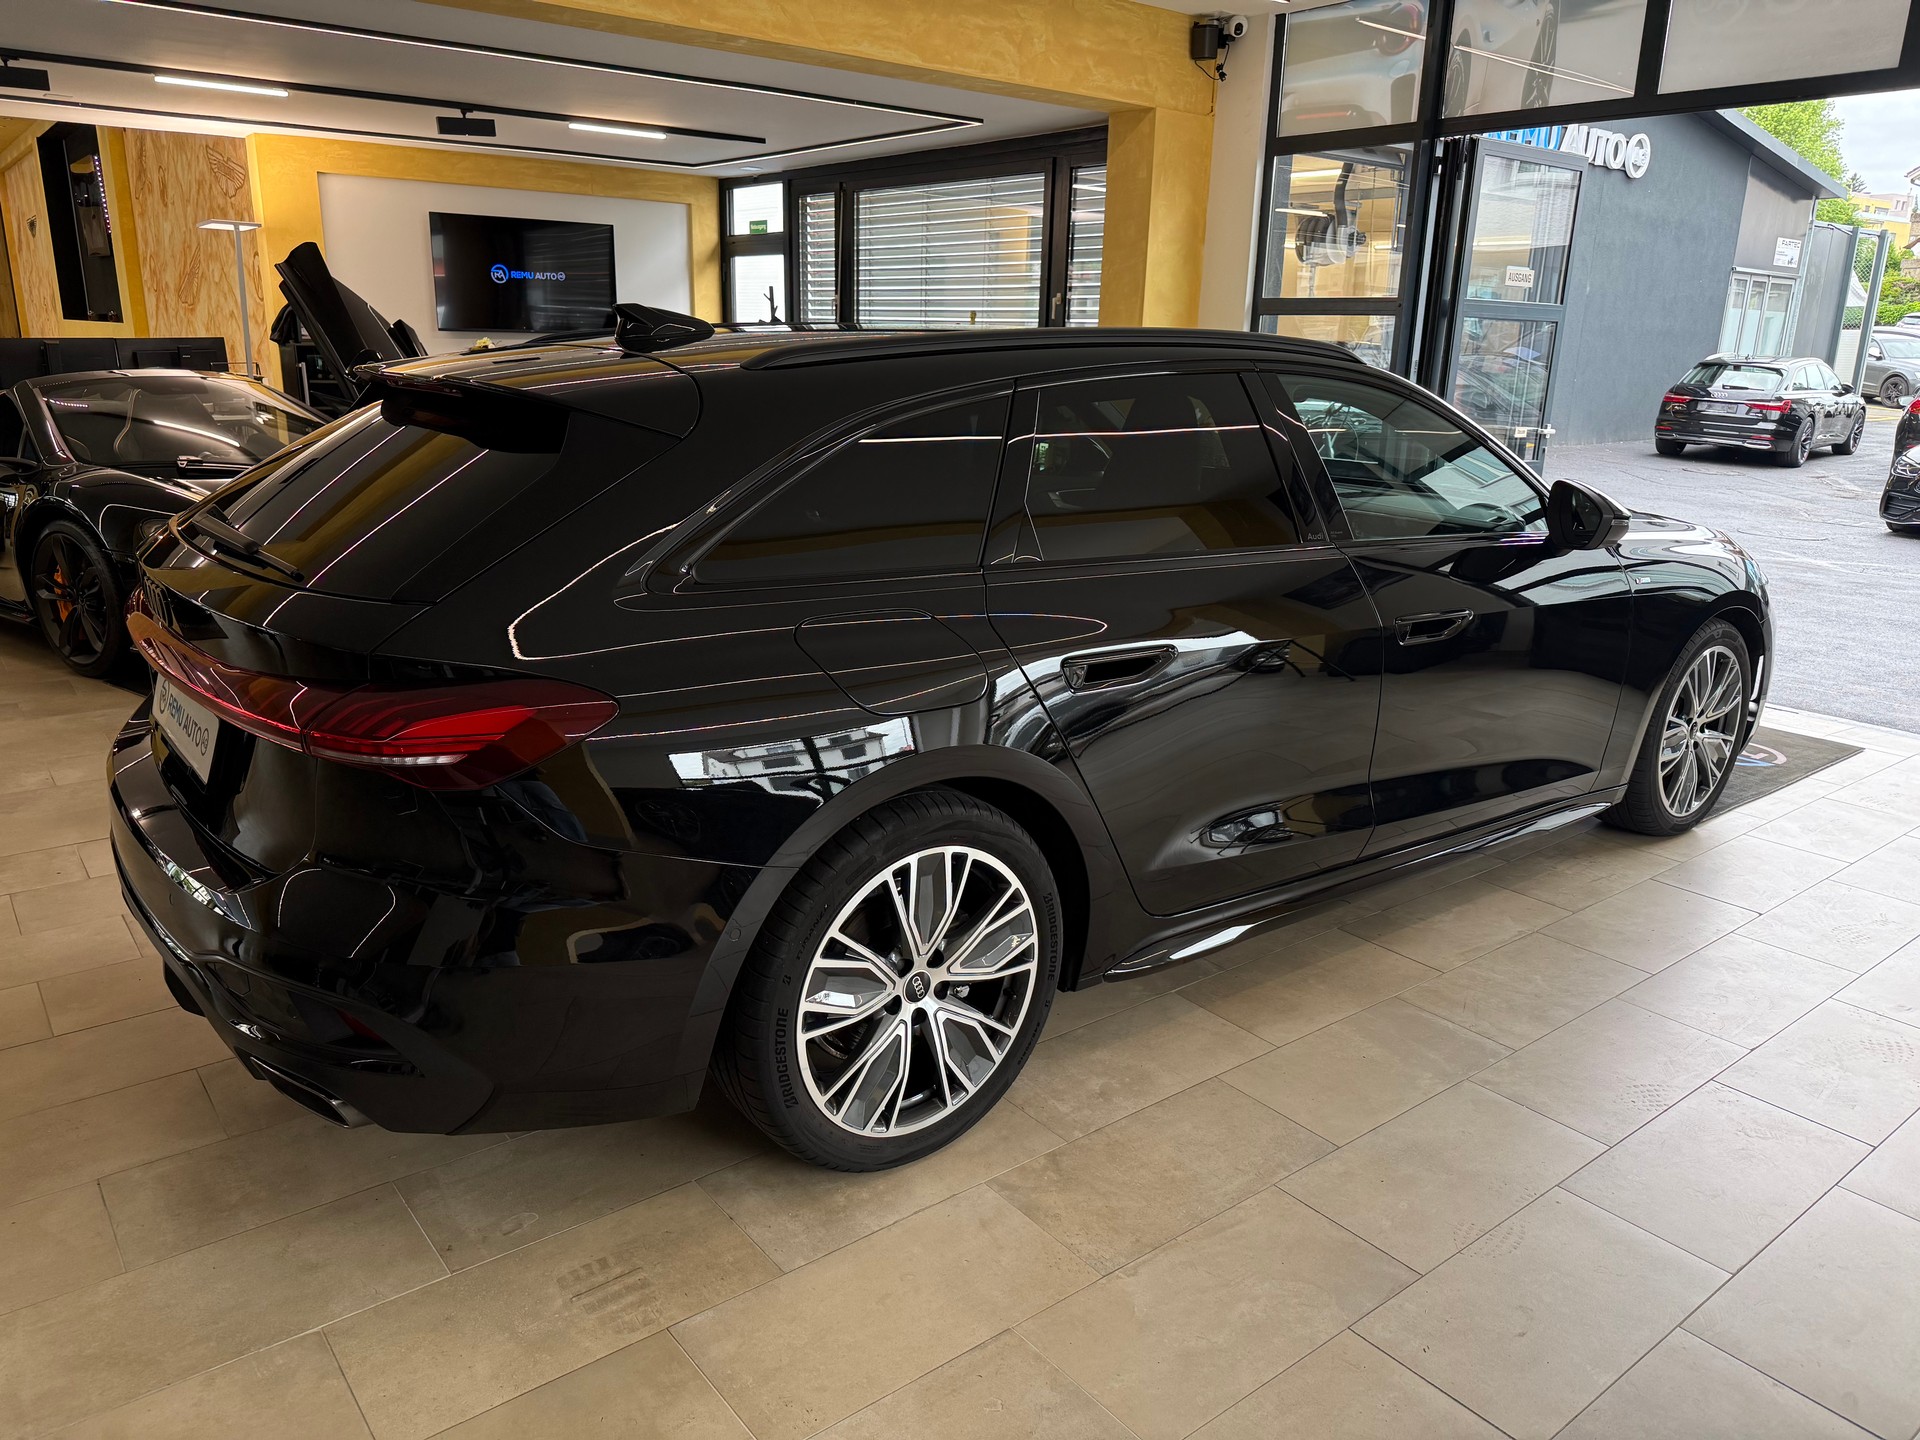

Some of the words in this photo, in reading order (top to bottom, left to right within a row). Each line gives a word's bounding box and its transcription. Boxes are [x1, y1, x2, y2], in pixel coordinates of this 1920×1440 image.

[1560, 124, 1626, 169] AUTO
[510, 271, 534, 279] REMU
[535, 272, 557, 280] AUTO
[1508, 272, 1532, 283] AUSGANG
[1307, 532, 1324, 540] Audi
[167, 692, 186, 727] REMU
[182, 713, 202, 747] AUTO
[1043, 892, 1059, 982] BRIDGESTONE
[774, 1007, 799, 1110] BRIDGESTONE
